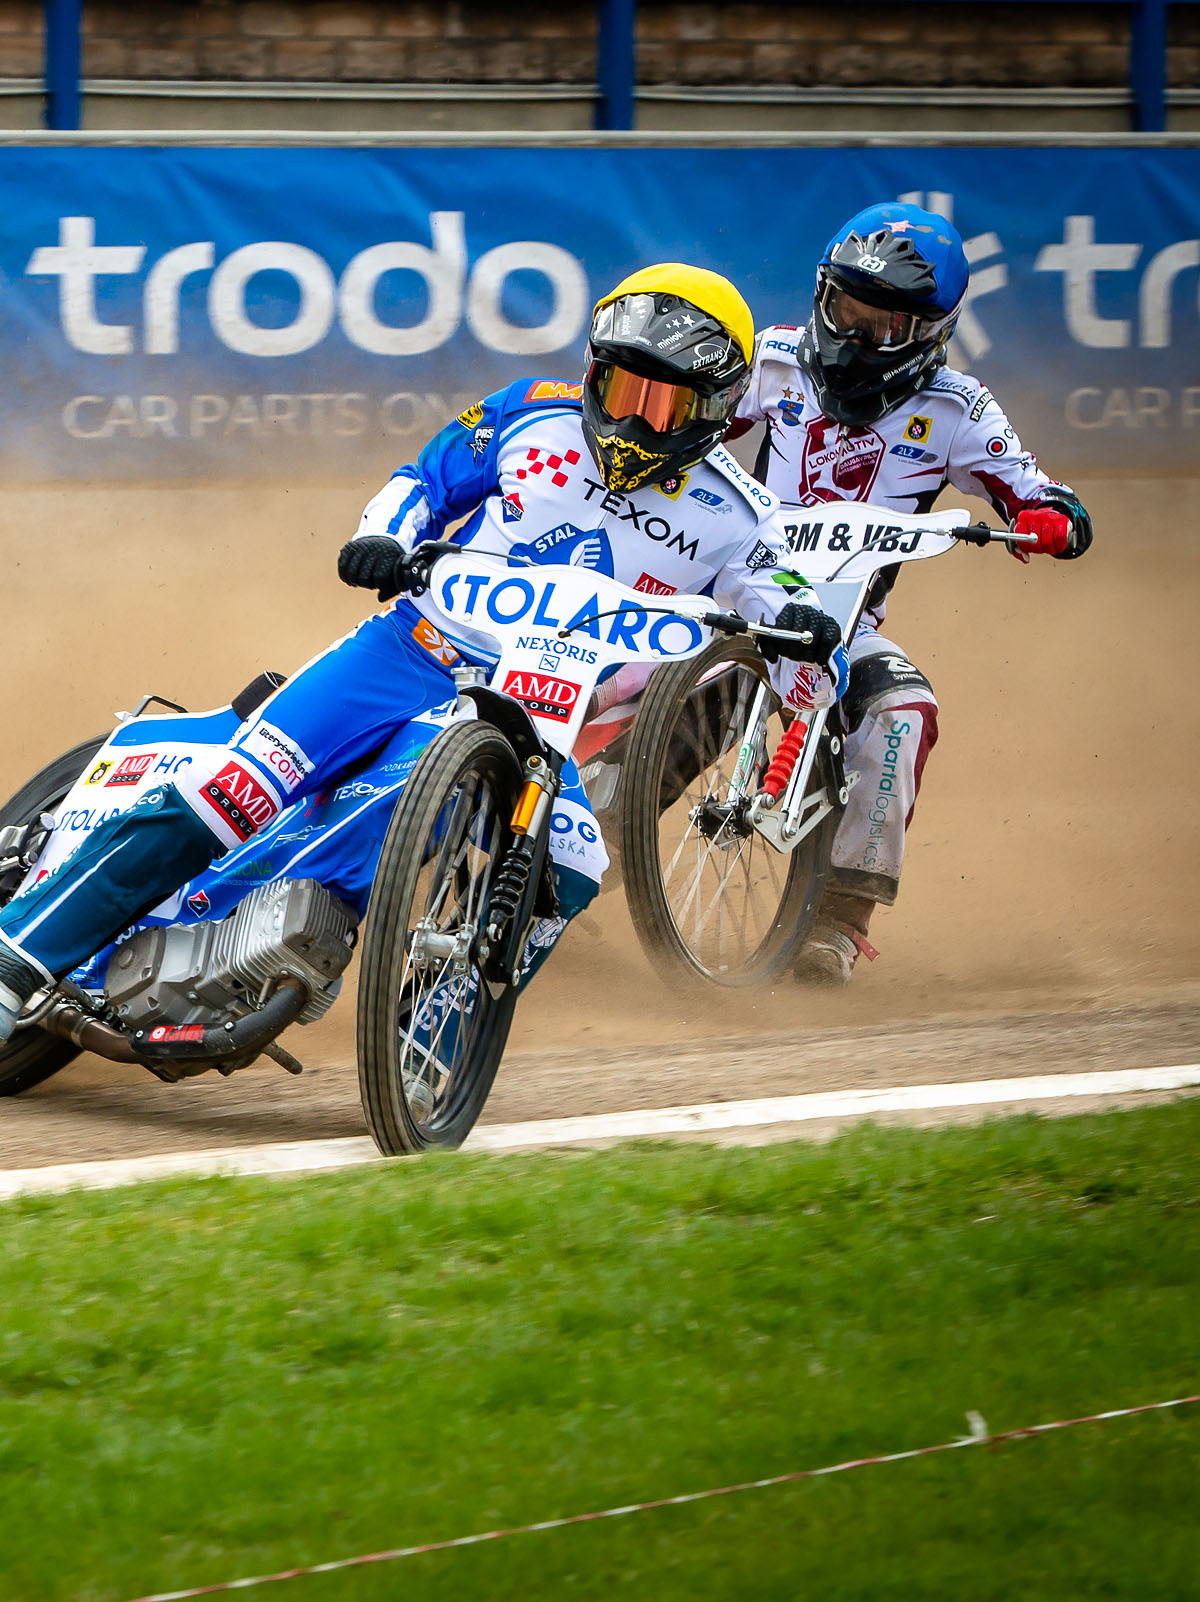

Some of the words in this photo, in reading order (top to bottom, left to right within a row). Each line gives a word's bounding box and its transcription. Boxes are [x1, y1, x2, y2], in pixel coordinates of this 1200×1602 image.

[26, 211, 589, 355] trodo
[1034, 215, 1200, 348] tr
[692, 349, 723, 370] EXTRANS
[62, 395, 177, 439] CAR
[191, 393, 366, 438] PARTS
[1065, 387, 1170, 429] CAR
[714, 451, 772, 508] STOLARO
[535, 524, 577, 555] STAL
[583, 477, 700, 562] TEXOM
[828, 522, 853, 552] &
[862, 523, 923, 554] VBJ
[441, 573, 703, 656] STOLARO
[516, 636, 598, 665] NEXORIS
[505, 674, 577, 705] AMD
[117, 757, 153, 774] AMD
[208, 786, 254, 836] GROUP
[216, 769, 272, 827] AMD
[864, 719, 911, 866] Spartalogistics
